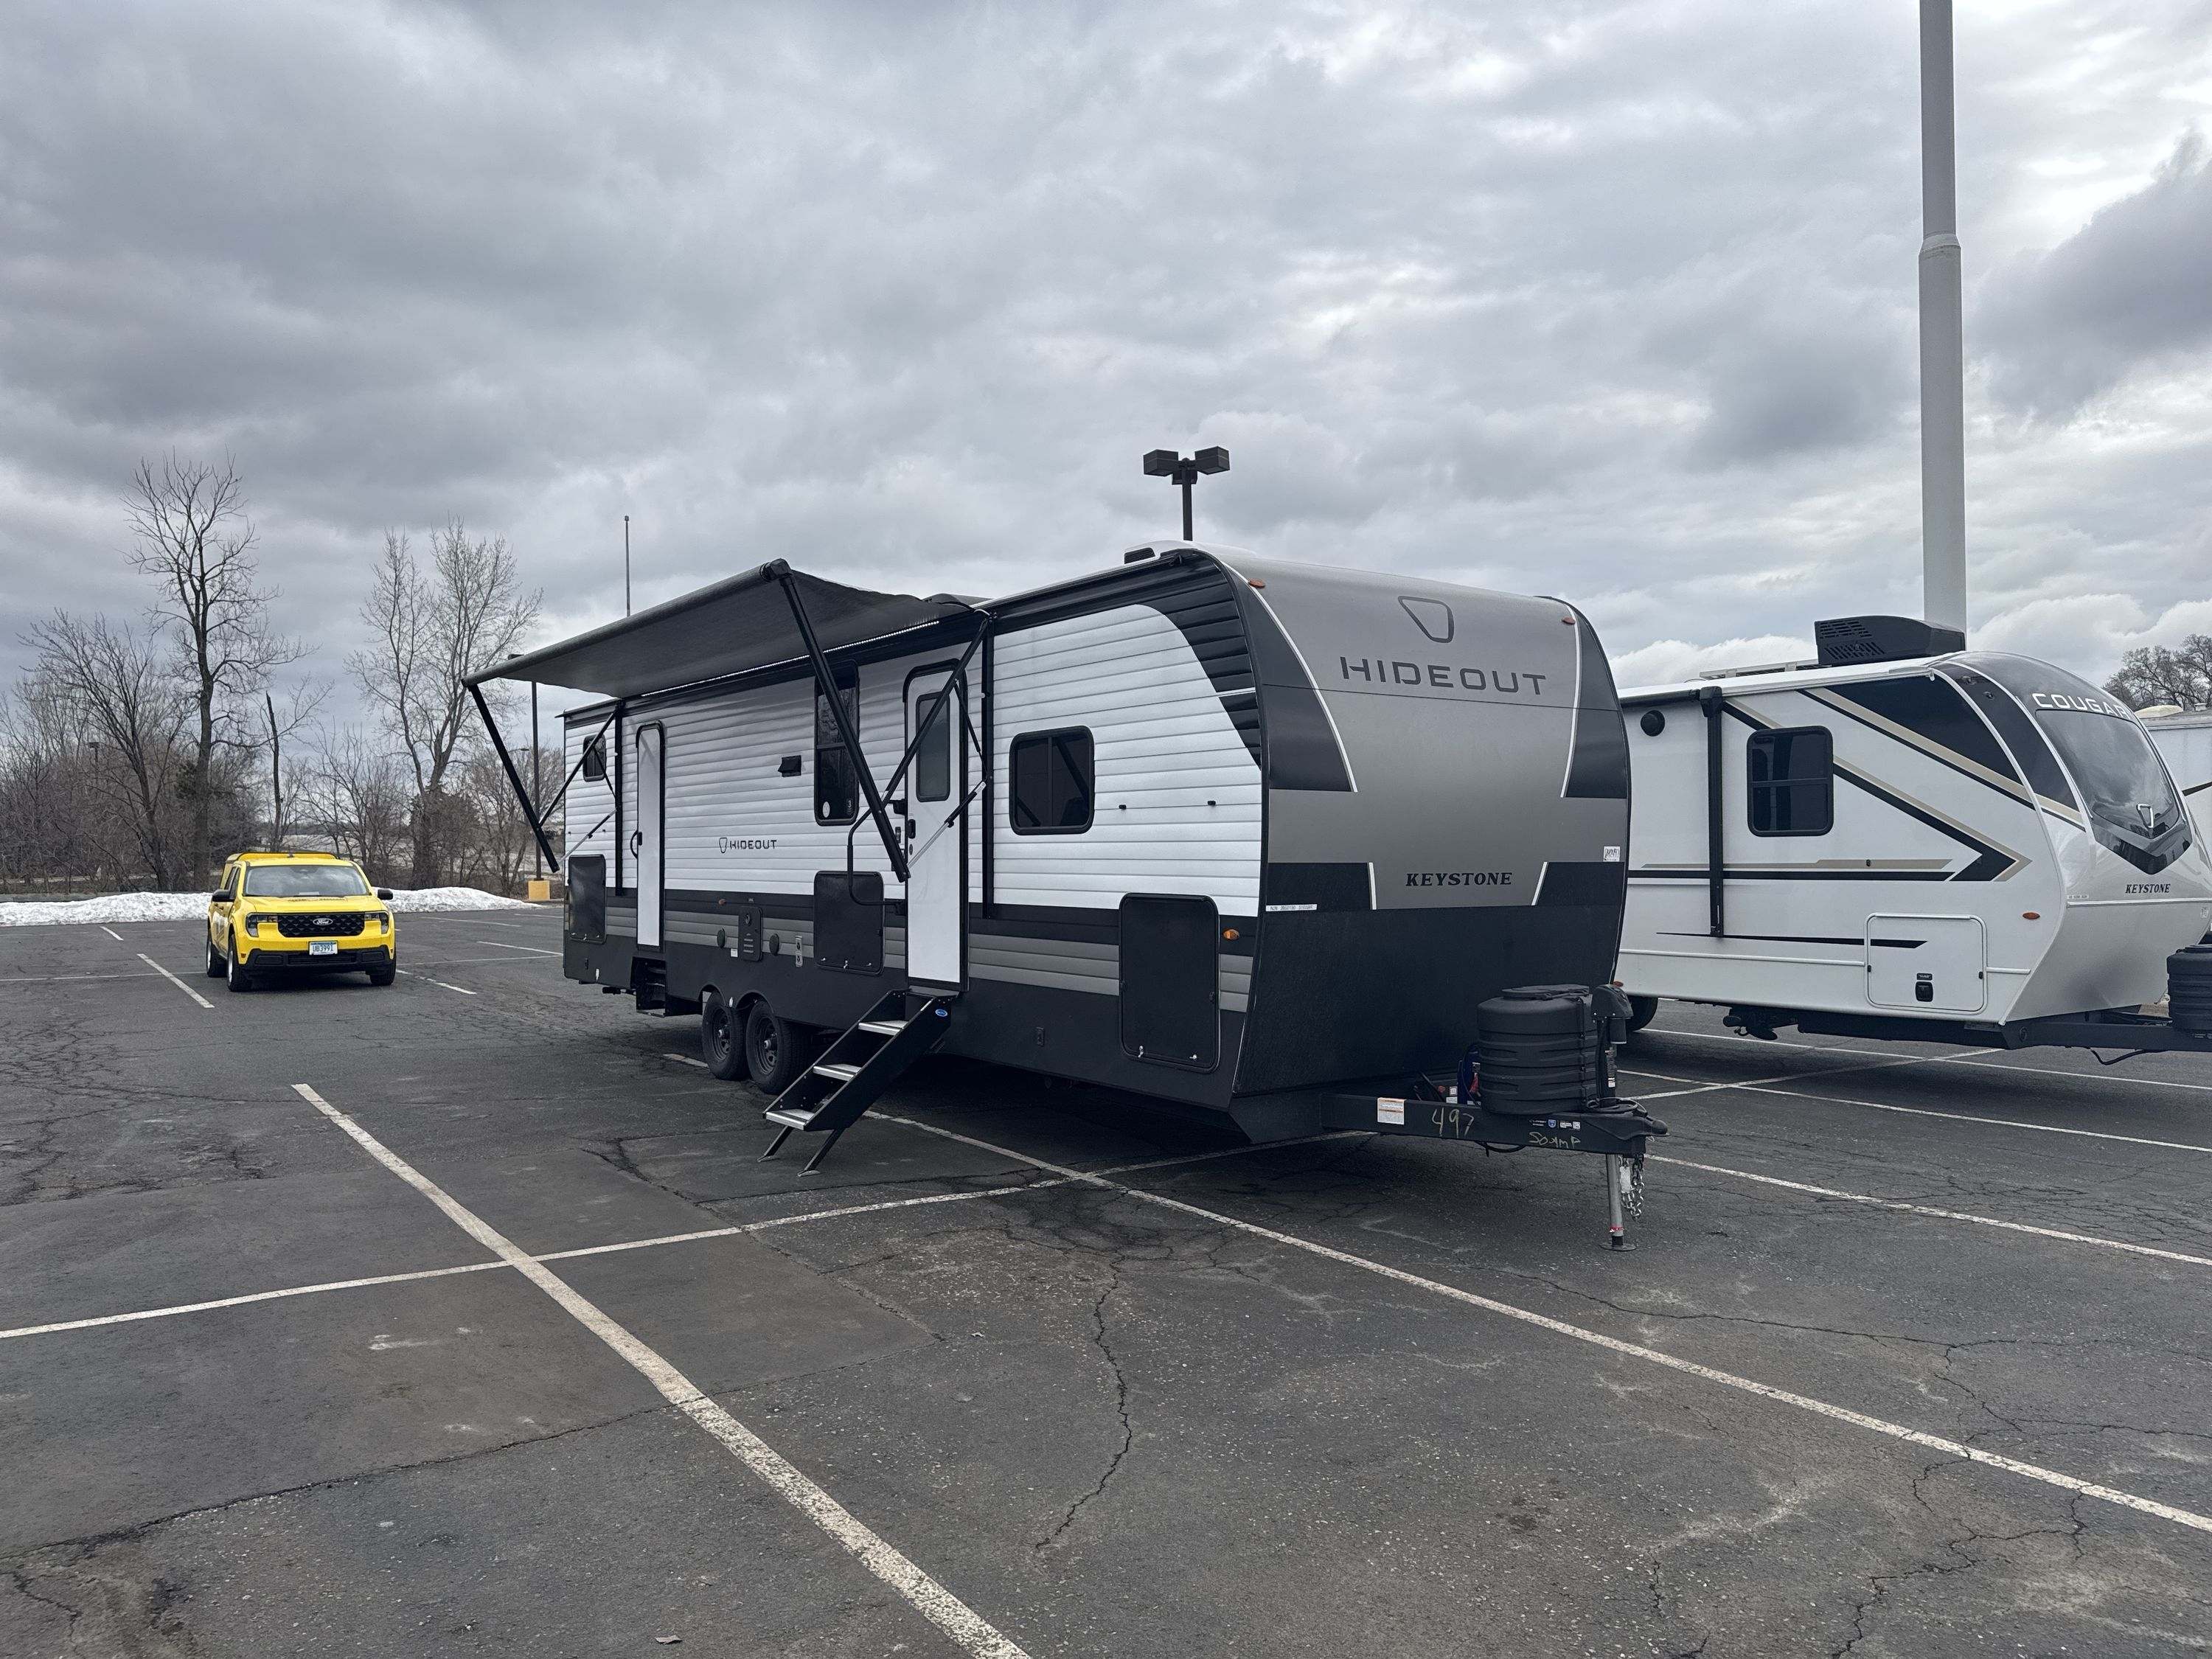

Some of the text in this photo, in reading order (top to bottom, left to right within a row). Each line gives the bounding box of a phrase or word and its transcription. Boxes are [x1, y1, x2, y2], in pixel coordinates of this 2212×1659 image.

[1340, 656, 1546, 695] HIDEOUT
[2032, 693, 2132, 720] COUGAR
[729, 840, 777, 849] HIDEOUT
[1405, 872, 1512, 886] KEYSTONE
[2125, 883, 2171, 894] KEYSTONE
[1432, 1107, 1474, 1138] 497
